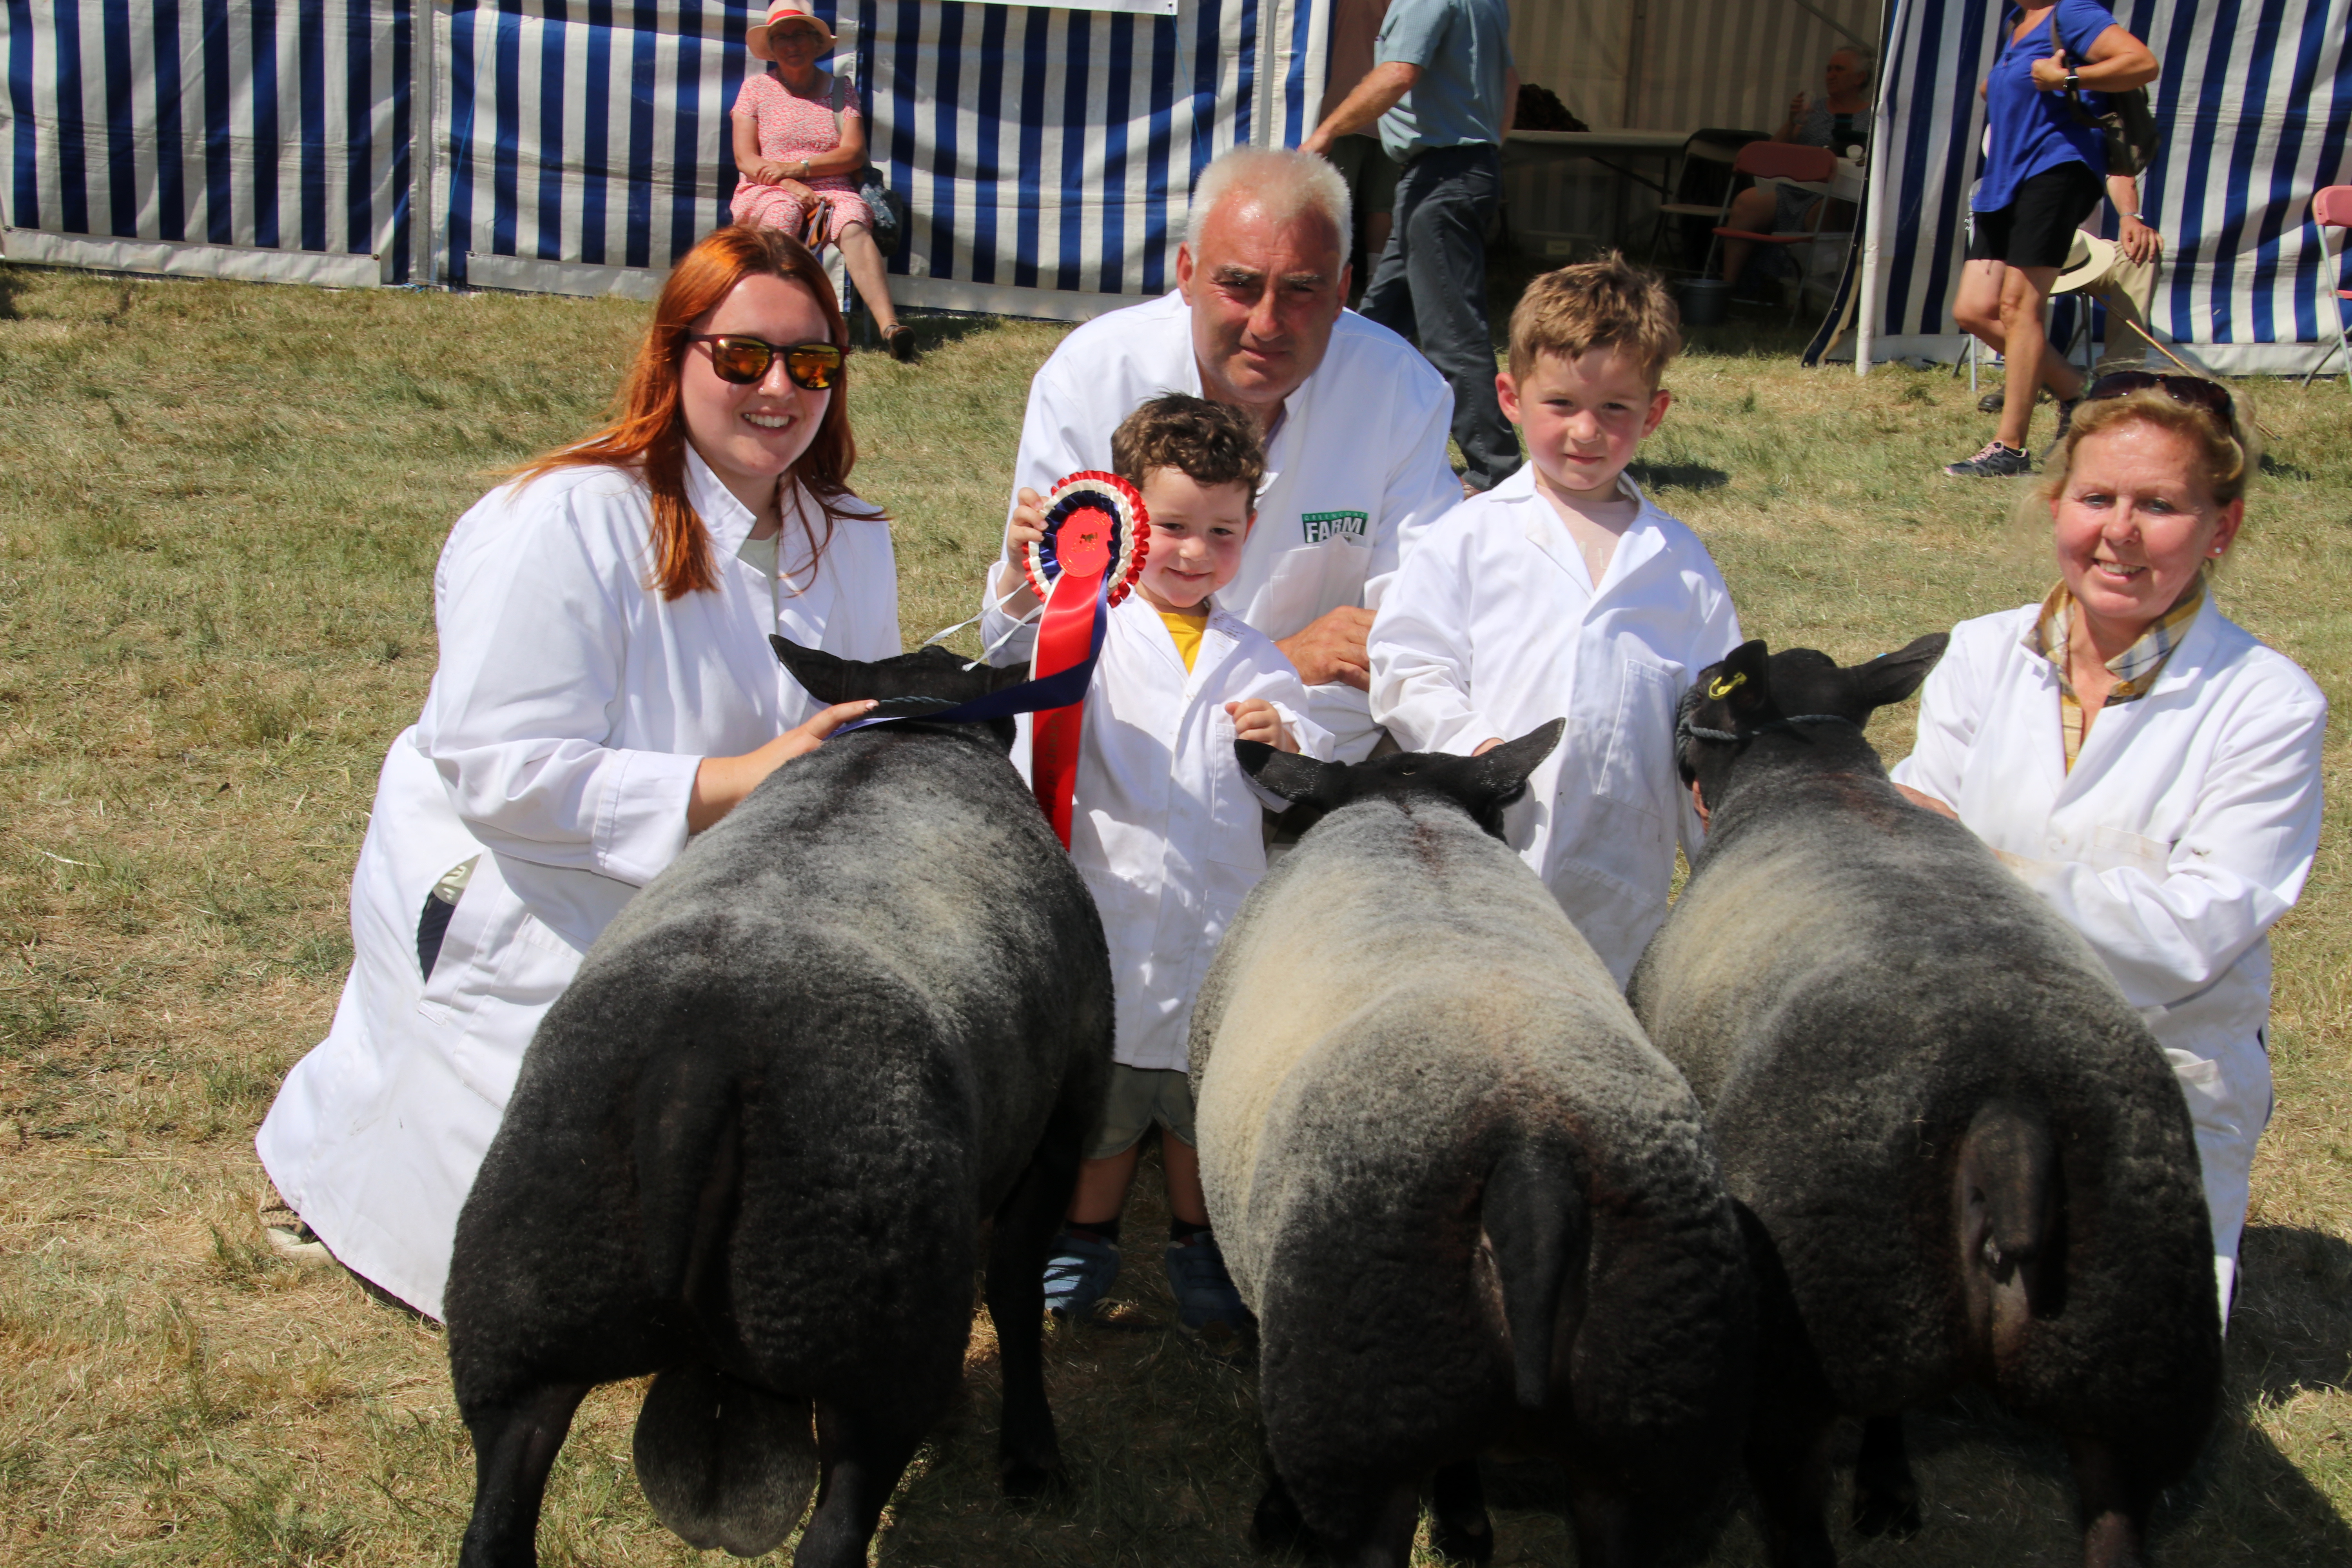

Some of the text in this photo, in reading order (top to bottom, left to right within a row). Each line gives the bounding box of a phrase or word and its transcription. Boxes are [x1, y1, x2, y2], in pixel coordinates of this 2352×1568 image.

[1305, 512, 1365, 521] GREENCOAT
[1306, 517, 1363, 543] FARM
[1044, 713, 1063, 764] Group
[1046, 769, 1059, 789] of
